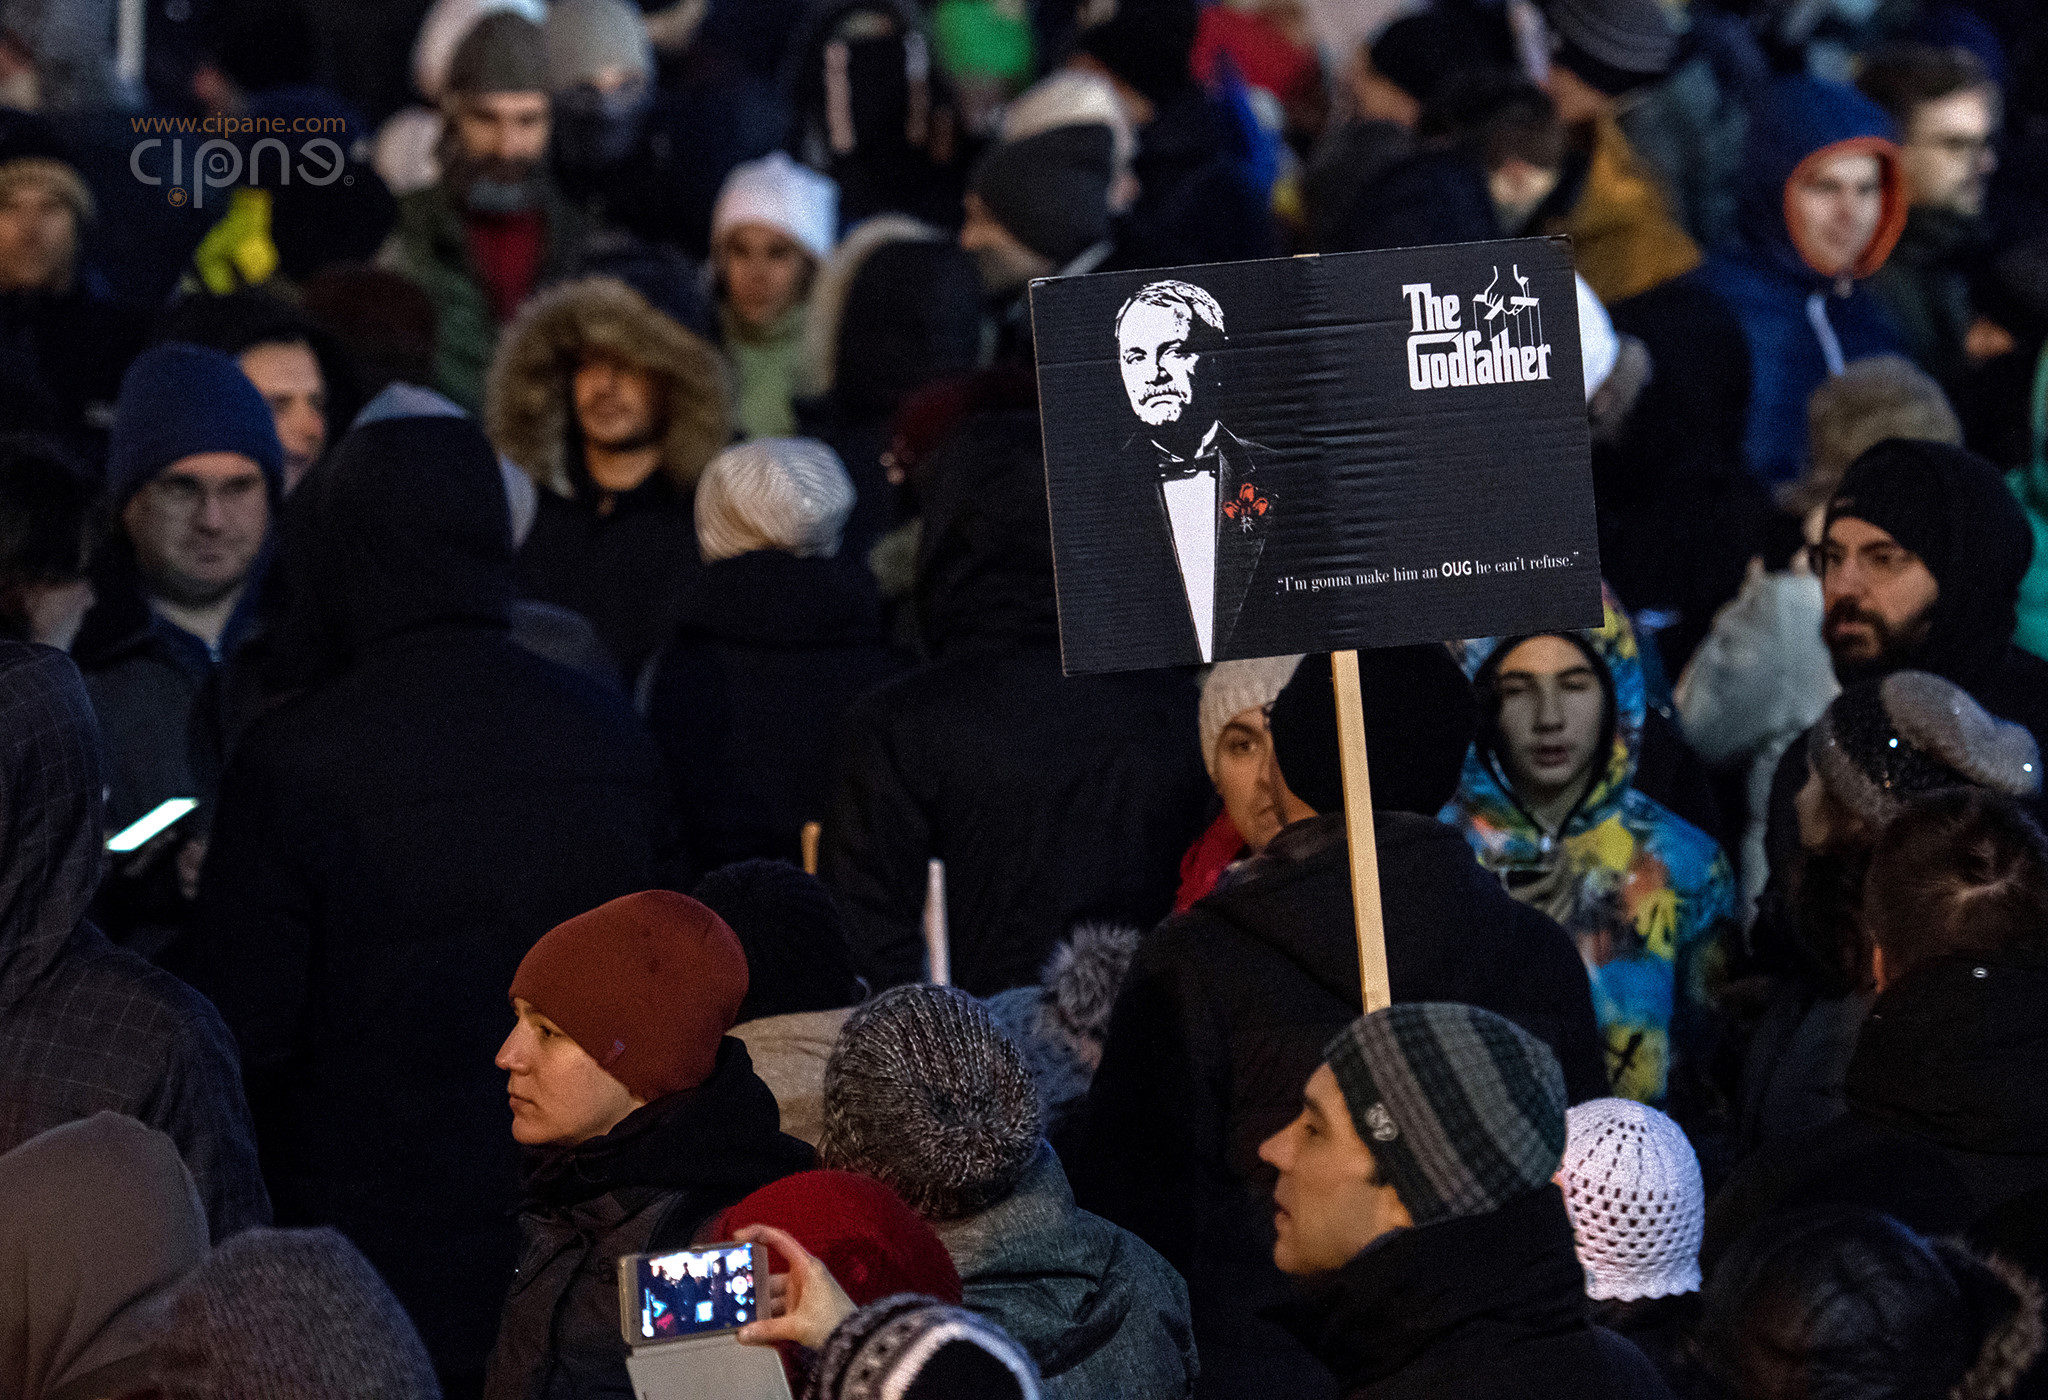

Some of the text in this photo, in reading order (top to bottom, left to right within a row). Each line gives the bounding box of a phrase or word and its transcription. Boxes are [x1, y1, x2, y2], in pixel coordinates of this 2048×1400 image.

[1402, 282, 1461, 333] The
[1406, 327, 1552, 391] Godfather
[1311, 575, 1351, 593] gonna
[1355, 569, 1390, 585] make
[1393, 567, 1418, 582] him
[1422, 567, 1438, 579] an
[1441, 560, 1472, 577] OUG
[1475, 560, 1491, 574] he
